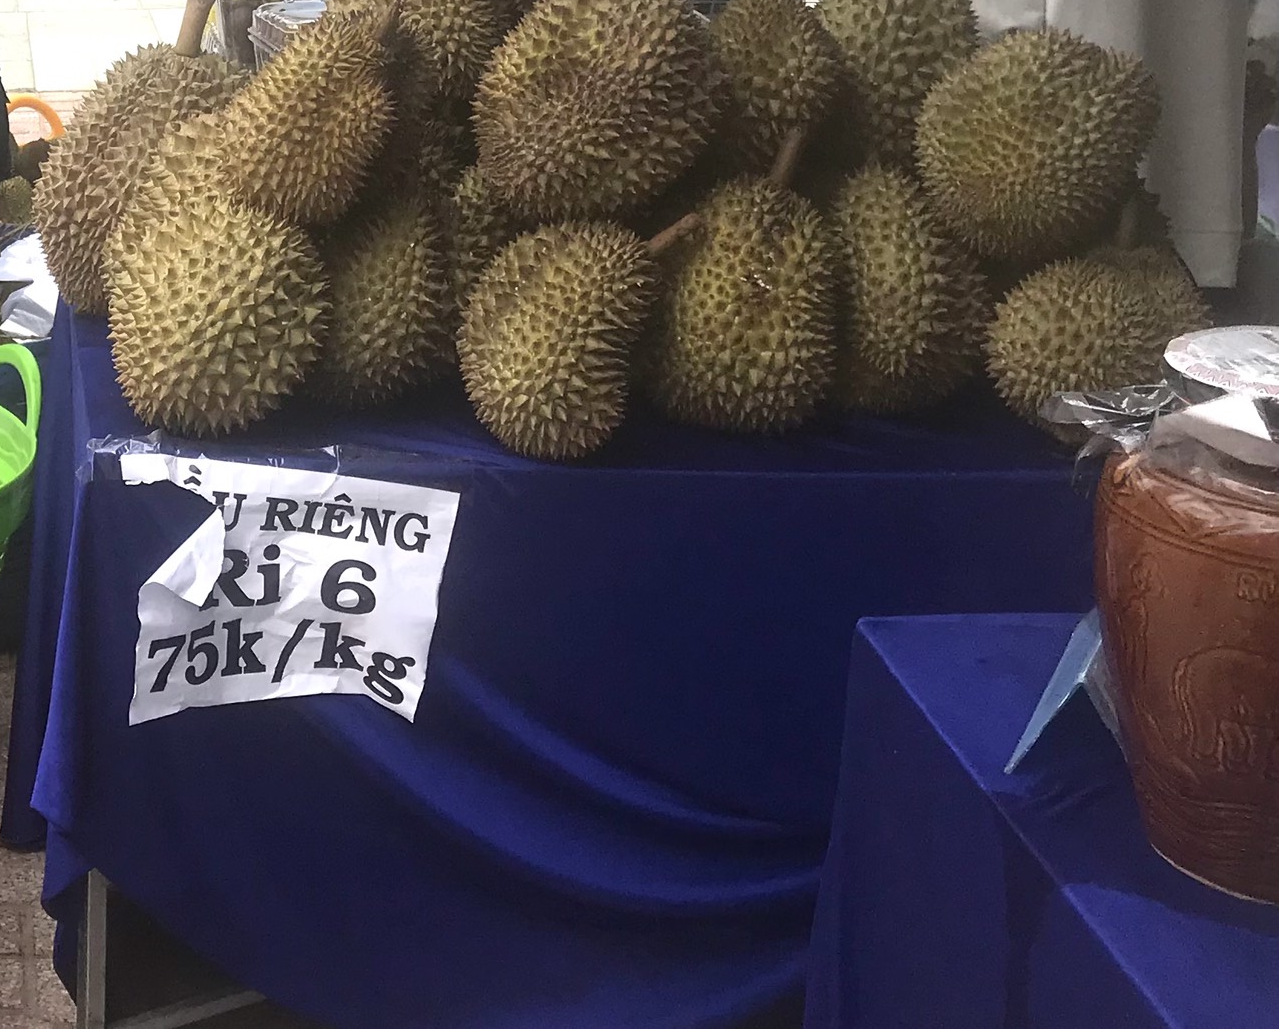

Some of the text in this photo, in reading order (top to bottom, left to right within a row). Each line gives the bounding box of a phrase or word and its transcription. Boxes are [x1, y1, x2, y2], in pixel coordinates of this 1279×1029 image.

[259, 493, 432, 554] RIÊNG
[198, 544, 377, 615] Ri 6
[147, 618, 417, 705] 75k/kg
